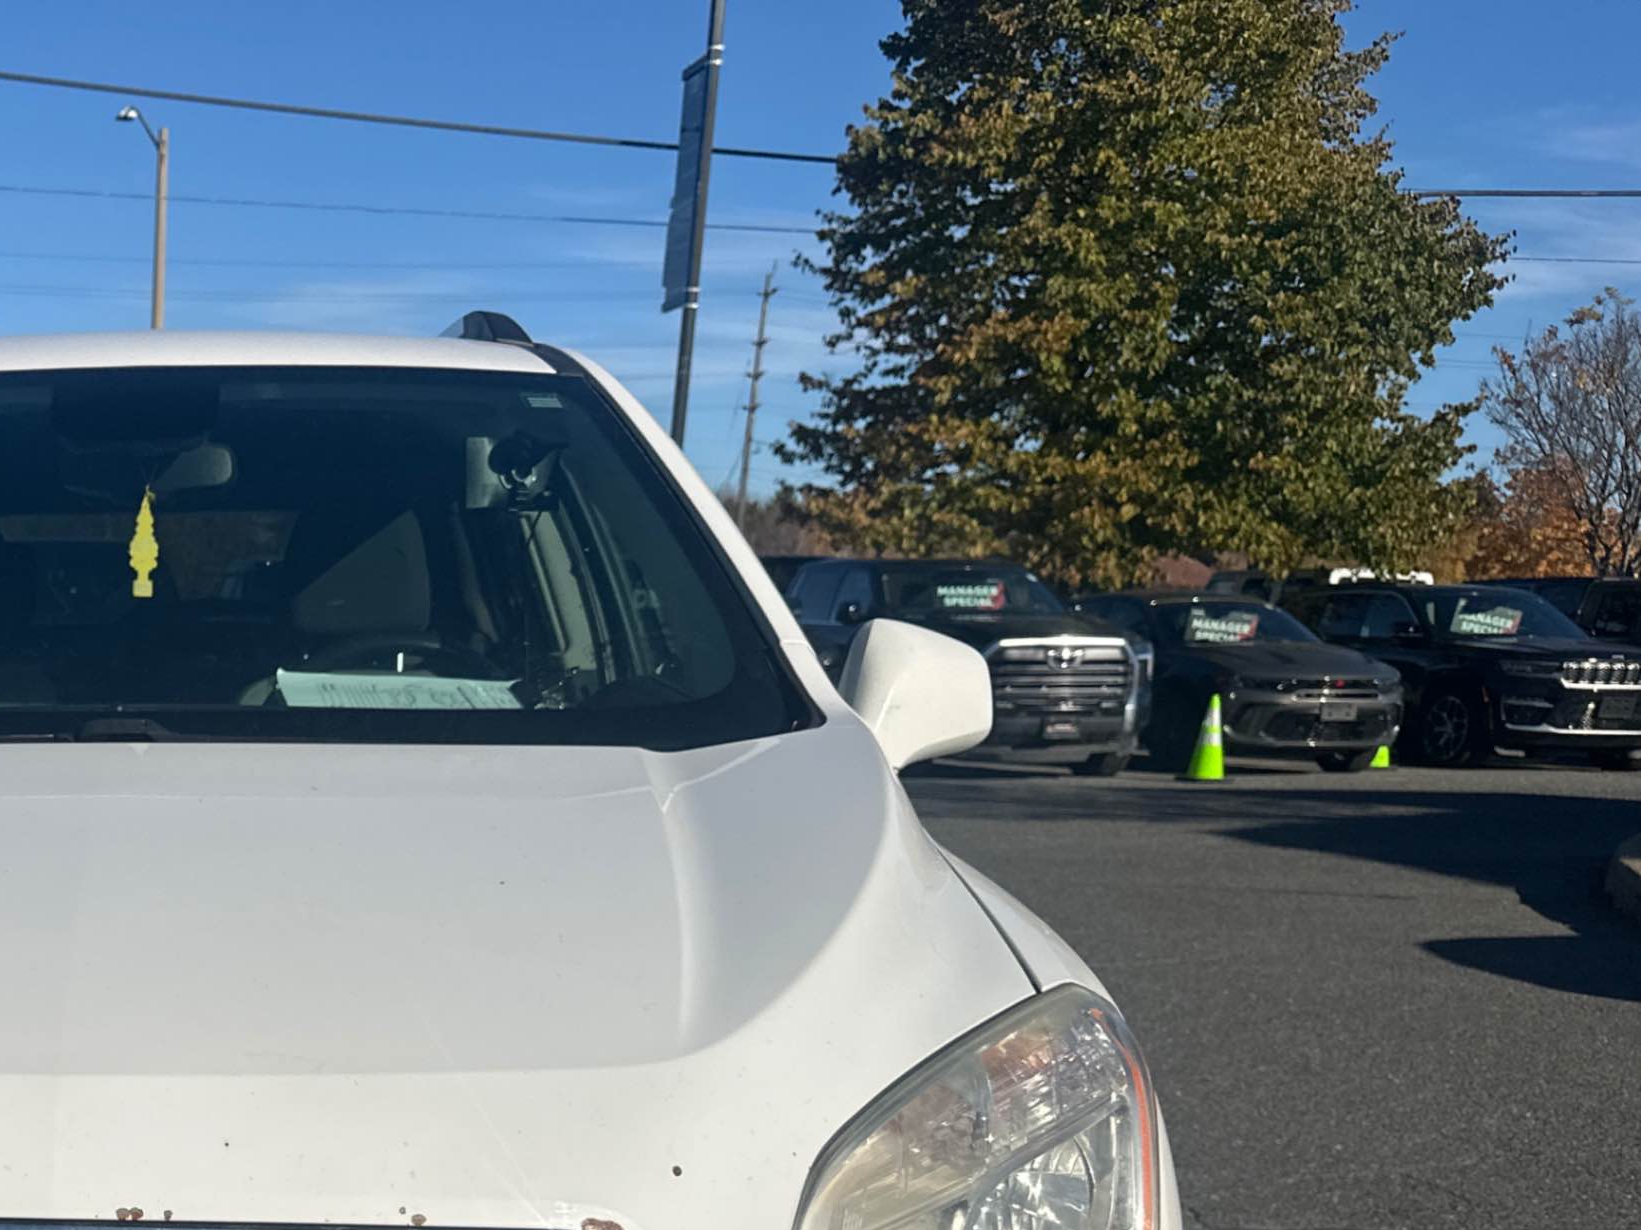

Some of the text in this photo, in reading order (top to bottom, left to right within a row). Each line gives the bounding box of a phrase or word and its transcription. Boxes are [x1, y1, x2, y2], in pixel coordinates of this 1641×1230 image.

[937, 585, 999, 596] MANAGER
[943, 597, 994, 607] SPECIAL
[1191, 619, 1251, 635] MANAGER
